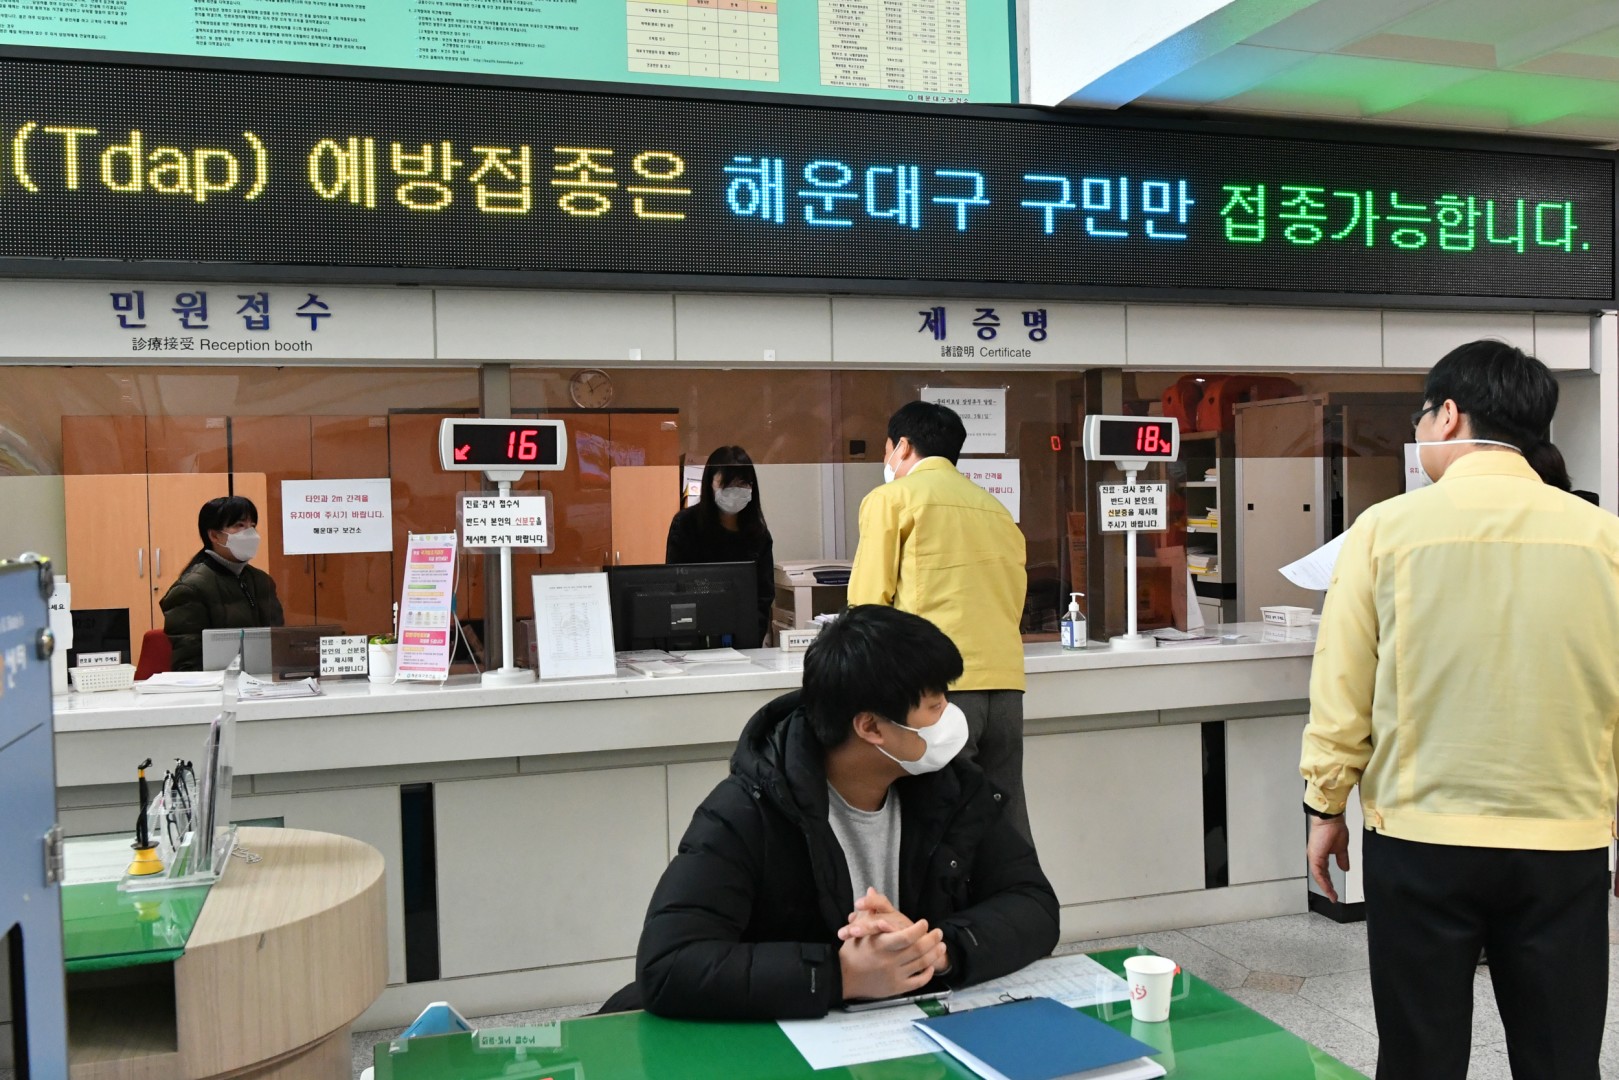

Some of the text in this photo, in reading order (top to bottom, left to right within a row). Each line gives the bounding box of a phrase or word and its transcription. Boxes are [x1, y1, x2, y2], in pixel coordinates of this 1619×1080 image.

[13, 121, 1590, 254] (Tdap) 예방접종은 해운대구 구민만 접종가능합니다.
[132, 336, 313, 353] 診療接受 Reception booth
[980, 347, 1031, 358] Certificate
[1136, 425, 1160, 452] 18
[507, 430, 538, 460] 16
[988, 486, 1015, 494] 바랍니다.
[1102, 486, 1115, 494] 진료
[1122, 486, 1136, 494] 검사
[1139, 485, 1152, 493] 접수
[305, 495, 328, 503] 타인과
[346, 494, 369, 503] 간격을
[1110, 497, 1155, 505] 반드시 본인의
[499, 499, 520, 508] 접수시
[290, 511, 385, 520] 유지하여 주시기 바랍니다.
[1108, 508, 1158, 517] 신분증을 제시해
[466, 517, 487, 526] 반드시
[490, 517, 511, 526] 본인의
[1107, 520, 1127, 528] 주시기
[465, 535, 487, 544] 제시해
[491, 535, 512, 544] 주시기
[515, 534, 545, 543] 바랍니다.
